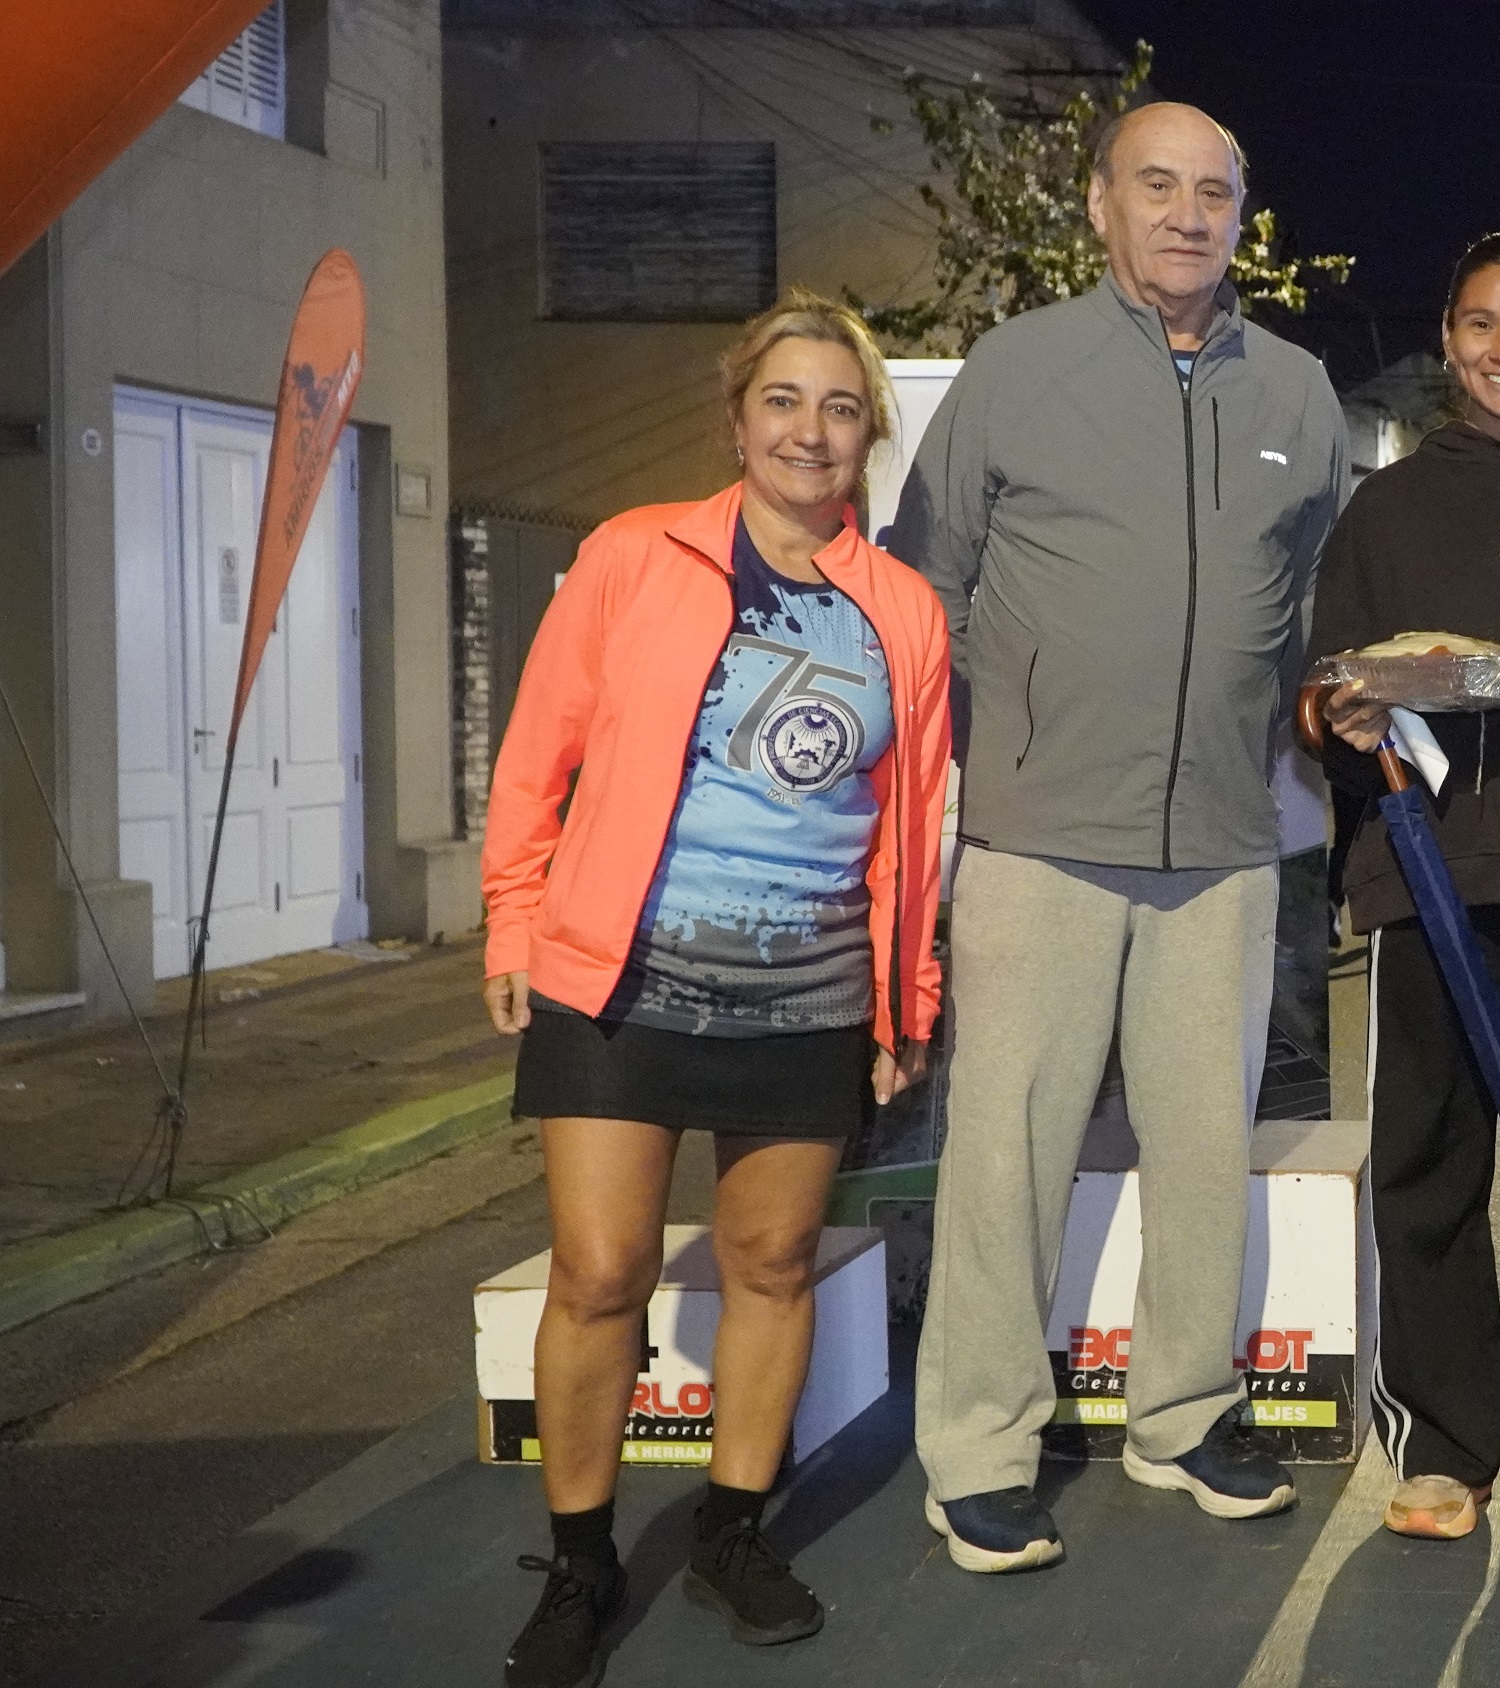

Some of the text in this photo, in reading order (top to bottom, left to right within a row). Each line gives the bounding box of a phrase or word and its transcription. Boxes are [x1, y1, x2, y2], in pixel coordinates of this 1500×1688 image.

[727, 632, 867, 793] 75
[1252, 1378, 1307, 1392] rtes
[655, 1423, 714, 1436] corte
